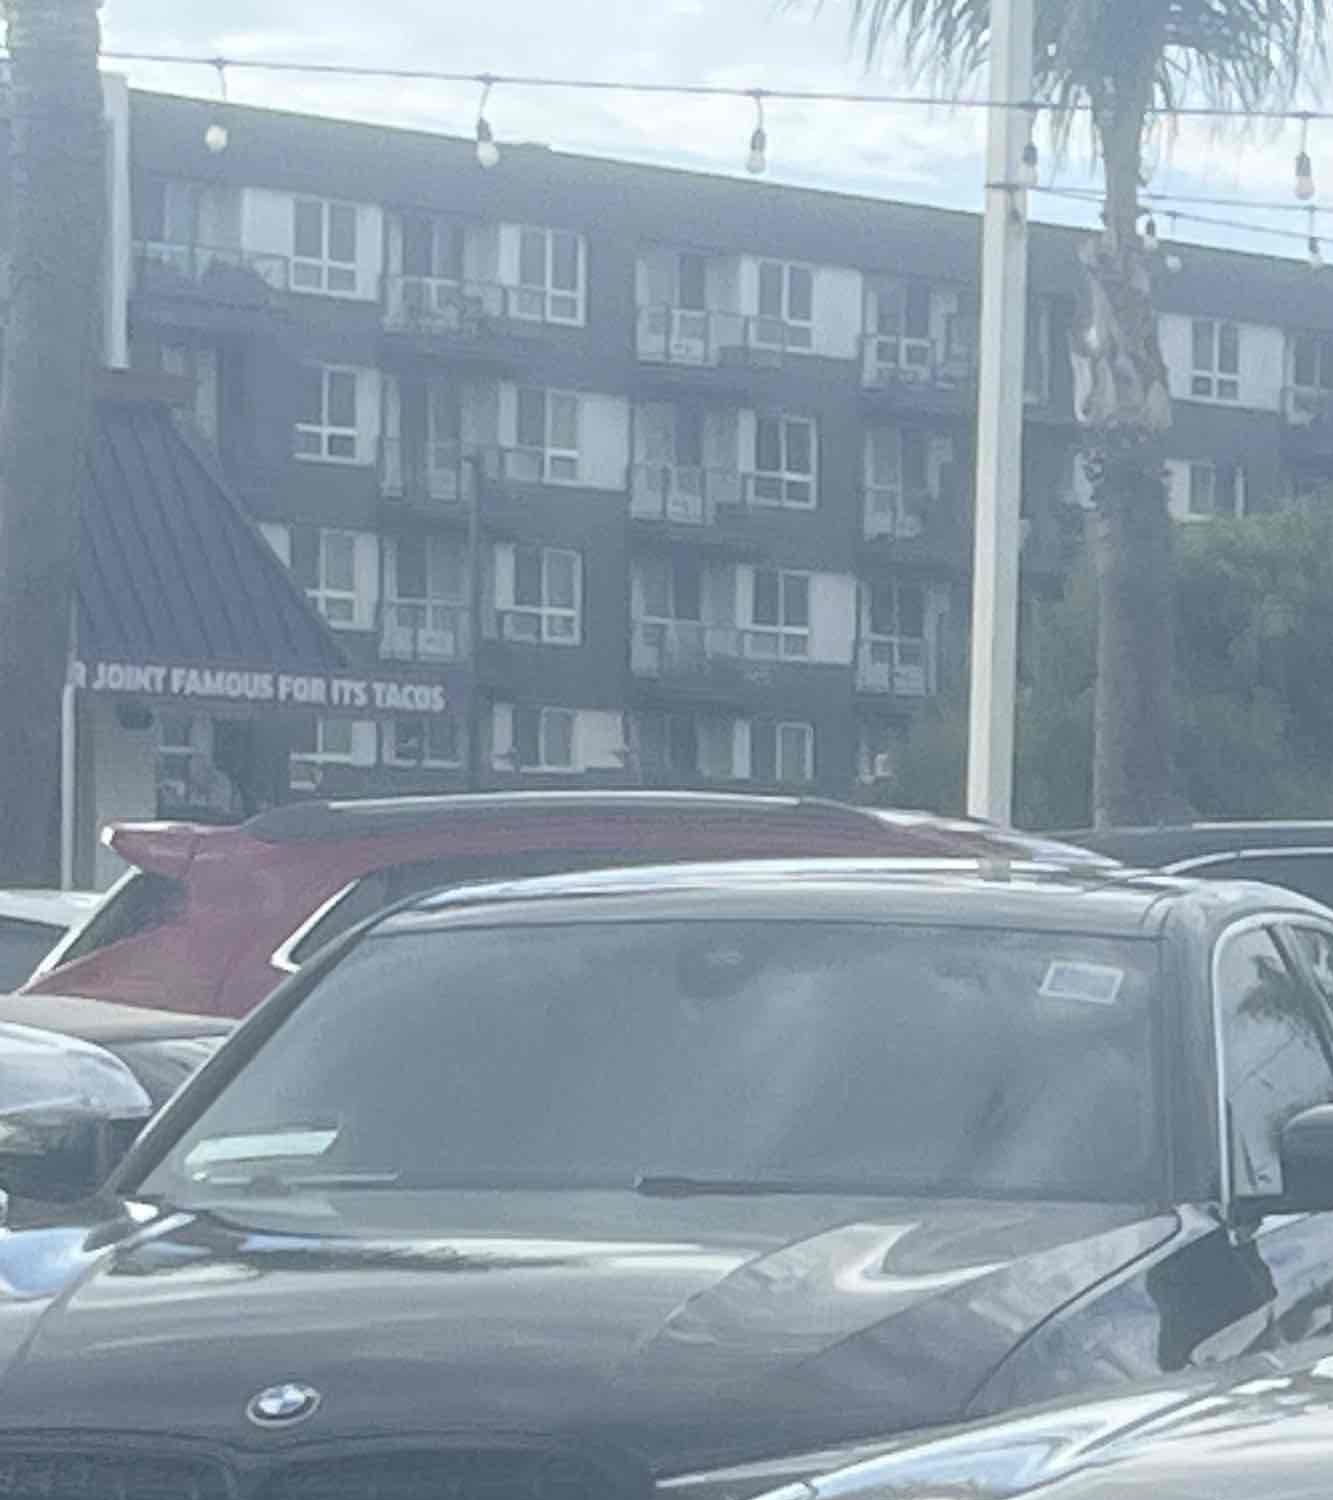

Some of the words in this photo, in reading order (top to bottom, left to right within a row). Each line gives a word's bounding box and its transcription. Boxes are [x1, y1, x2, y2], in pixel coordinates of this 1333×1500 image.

[93, 663, 167, 693] JOINT
[171, 668, 274, 702] FAMOUS
[277, 674, 326, 704] FOR
[332, 678, 369, 707] ITS
[372, 681, 445, 712] TACOS
